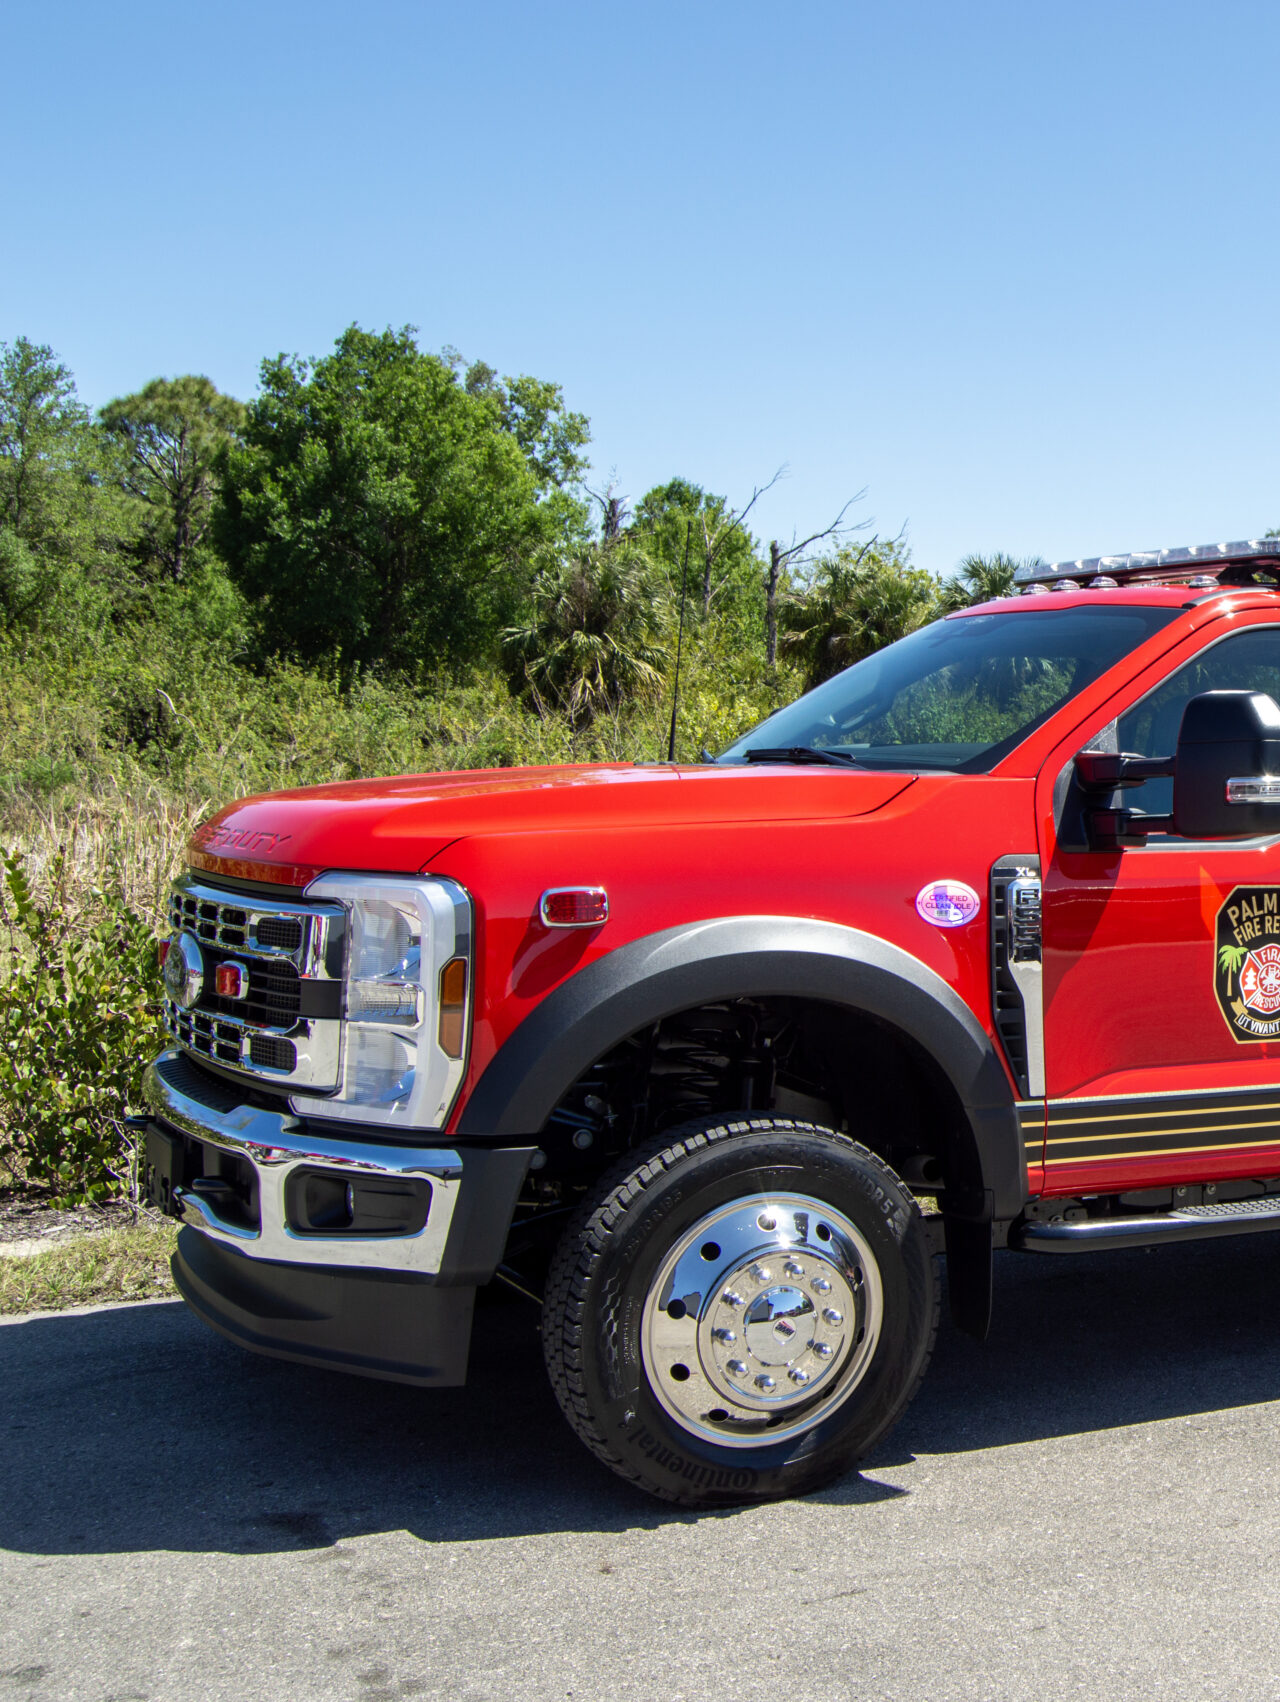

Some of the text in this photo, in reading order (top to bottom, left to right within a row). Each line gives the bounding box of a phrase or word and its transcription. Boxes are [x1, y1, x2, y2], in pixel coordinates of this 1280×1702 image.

[925, 902, 951, 910] CLEAN
[929, 894, 968, 902] CERTIFIED
[1226, 893, 1277, 928] PALM
[1233, 917, 1262, 946] FIRE
[1238, 1014, 1252, 1028] UT
[1250, 1020, 1280, 1034] VIVANT
[627, 1426, 759, 1493] Continental
